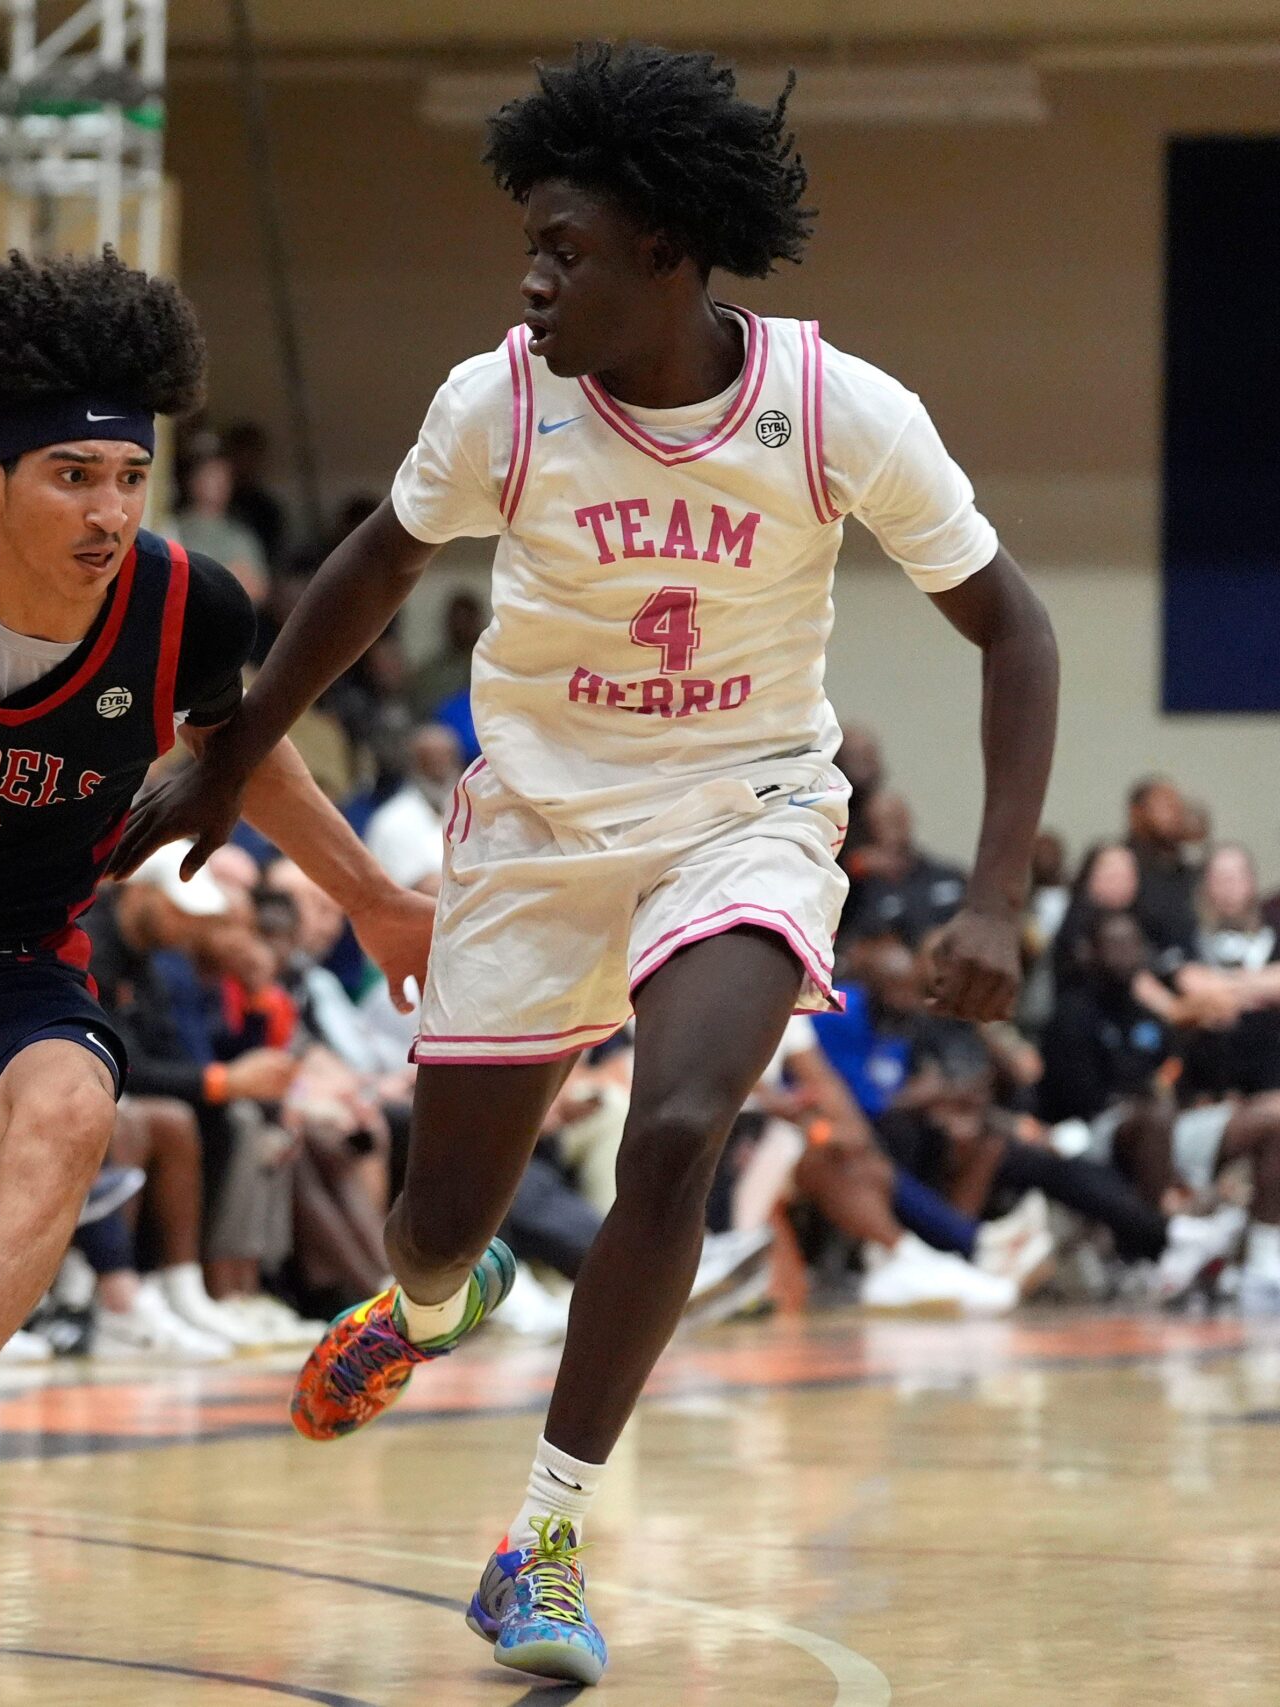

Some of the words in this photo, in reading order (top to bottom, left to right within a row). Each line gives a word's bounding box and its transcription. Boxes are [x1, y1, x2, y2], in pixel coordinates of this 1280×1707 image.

[760, 421, 788, 434] EYBL
[574, 498, 761, 568] TEAM
[629, 585, 701, 675] 4
[100, 695, 130, 706] EYBL
[568, 666, 752, 719] HERRO
